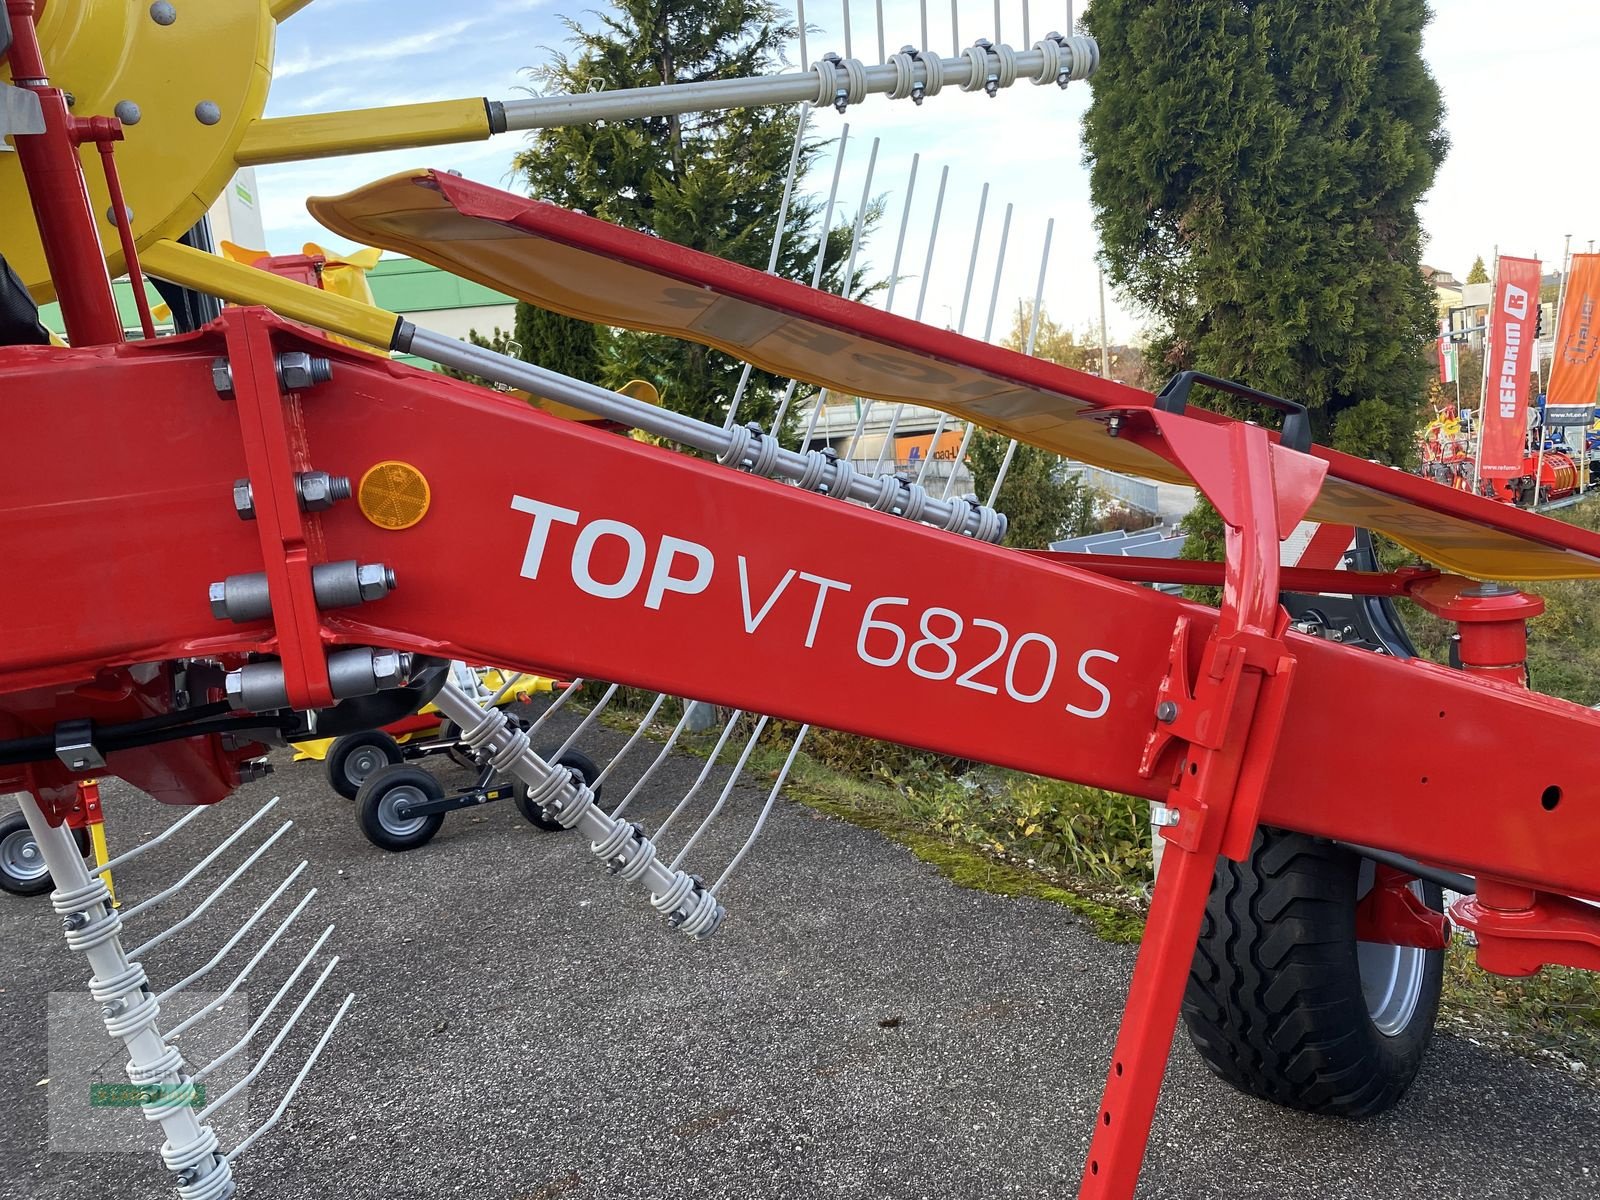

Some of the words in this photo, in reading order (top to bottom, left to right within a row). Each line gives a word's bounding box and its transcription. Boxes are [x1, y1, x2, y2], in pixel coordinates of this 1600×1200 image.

[1499, 322, 1521, 419] REFORM
[511, 494, 715, 610] TOP
[737, 555, 852, 648] VT
[856, 596, 1058, 703] 6820
[1065, 649, 1120, 719] S
